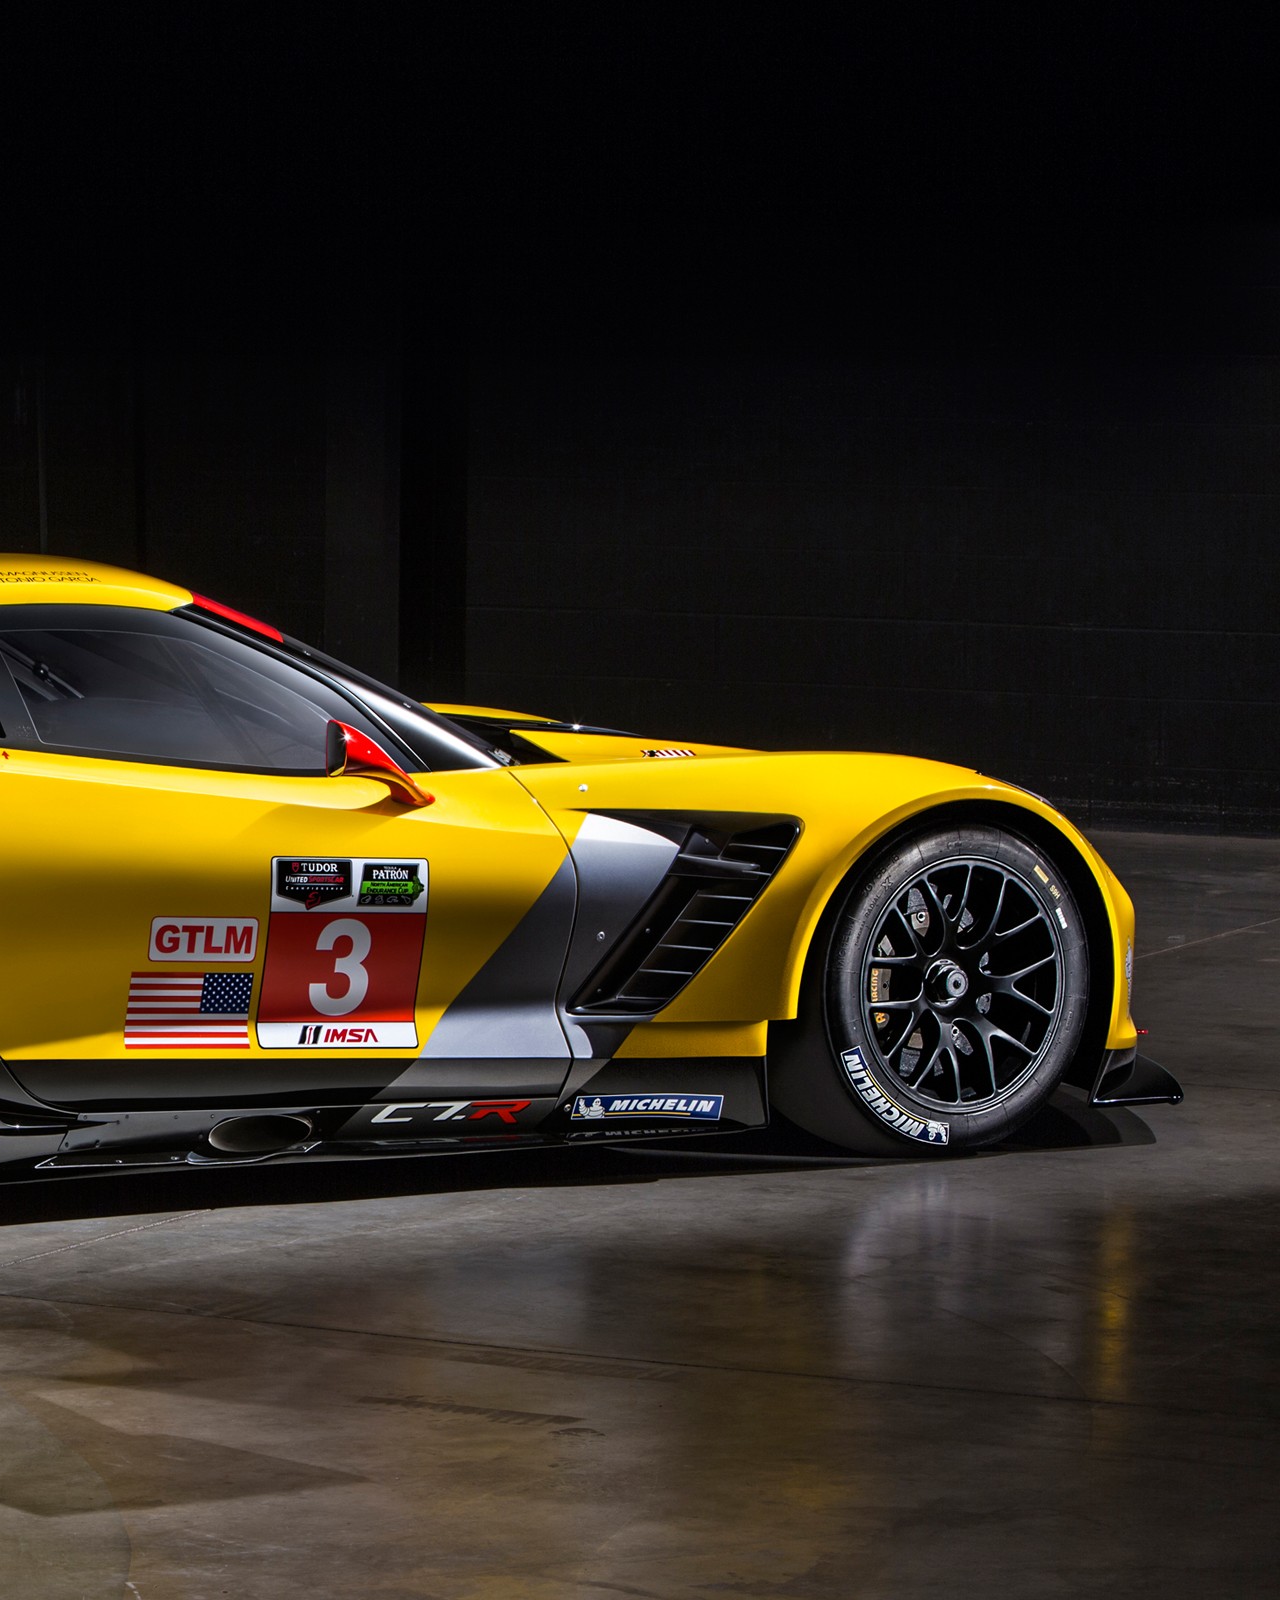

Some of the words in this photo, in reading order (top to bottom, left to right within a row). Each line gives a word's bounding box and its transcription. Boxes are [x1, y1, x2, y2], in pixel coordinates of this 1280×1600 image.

[301, 862, 338, 872] TUDOR
[372, 868, 409, 880] PATRÓN
[285, 875, 308, 883] UNITED
[865, 894, 880, 918] RADIAL
[154, 924, 254, 954] GTLM
[308, 918, 372, 1016] 3
[324, 1028, 379, 1043] IMSA
[844, 1054, 926, 1137] MICHELIN
[609, 1098, 716, 1113] MICHELIN
